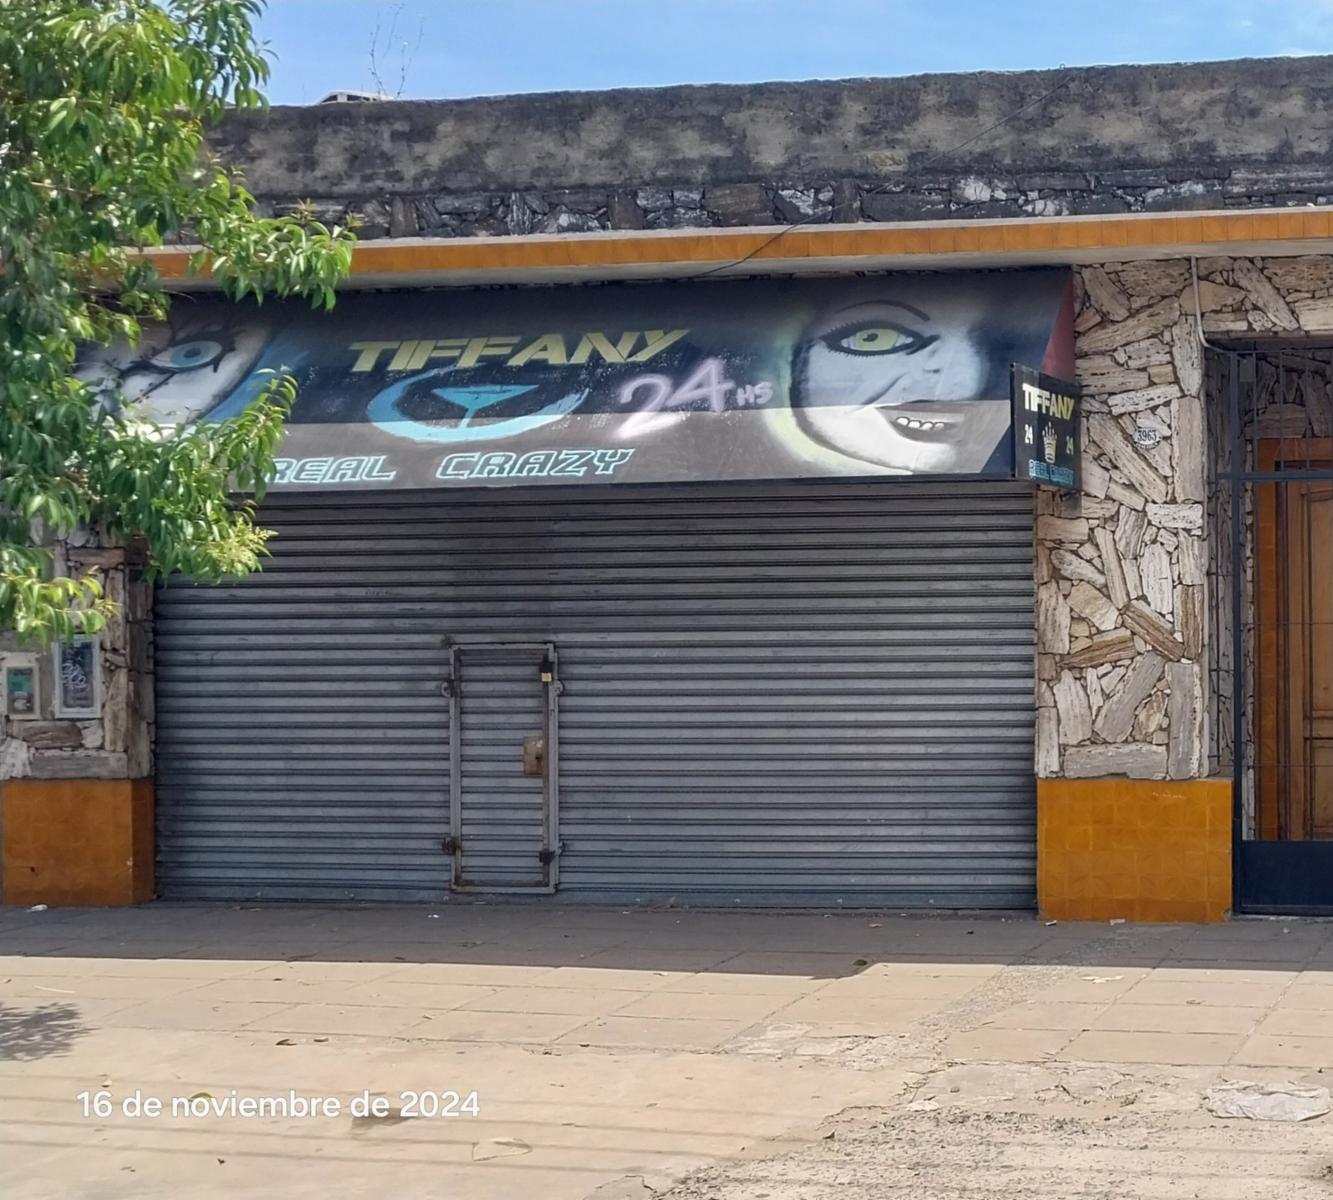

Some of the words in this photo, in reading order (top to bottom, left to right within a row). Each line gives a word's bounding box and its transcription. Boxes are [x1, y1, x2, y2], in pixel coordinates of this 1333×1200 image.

[348, 328, 692, 373] TIFFANY
[613, 357, 735, 438] 24
[737, 380, 774, 406] HS
[1022, 383, 1075, 421] TIFFANY
[1024, 424, 1034, 445] 24
[1066, 435, 1074, 455] 24
[252, 455, 397, 484] REAL
[435, 448, 635, 481] CRAZY
